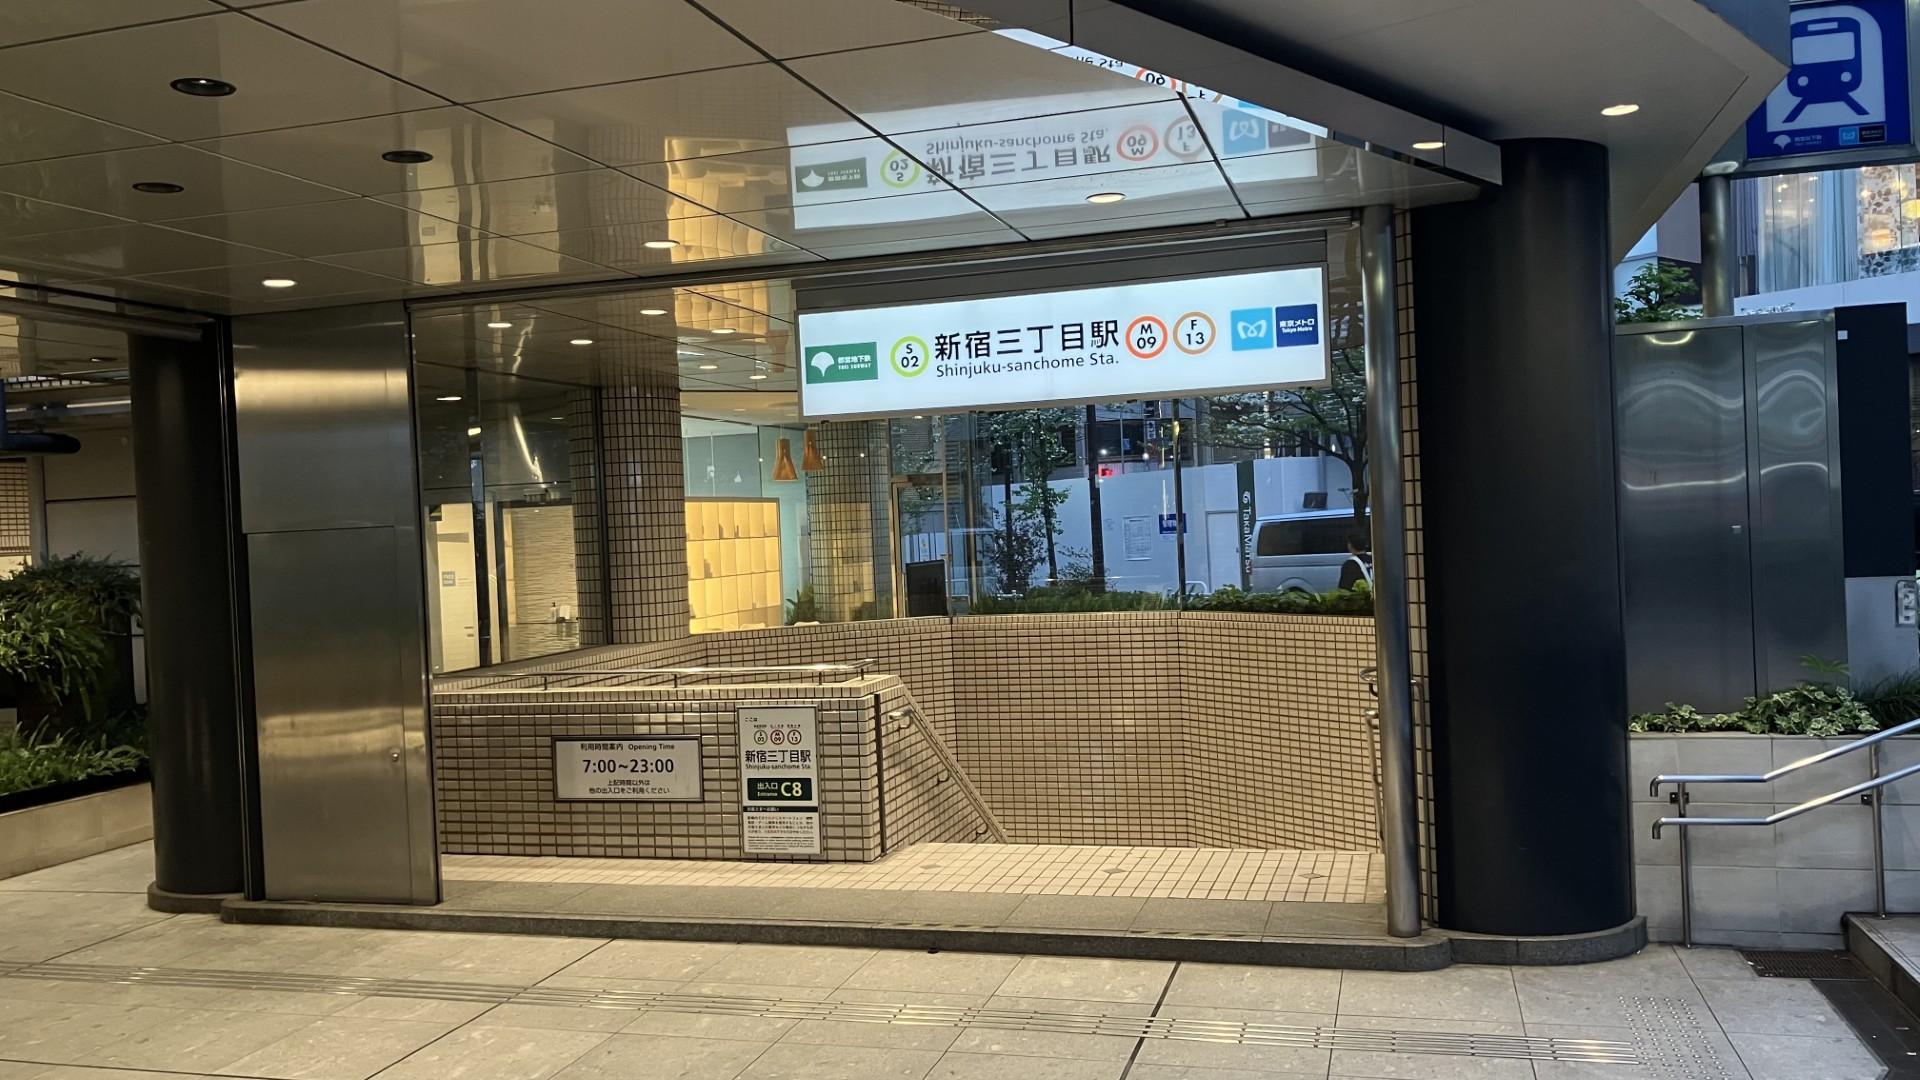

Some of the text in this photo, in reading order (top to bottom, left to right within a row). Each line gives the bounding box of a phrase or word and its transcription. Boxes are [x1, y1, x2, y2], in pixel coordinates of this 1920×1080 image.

[1140, 323, 1153, 335] M
[1190, 319, 1198, 331] F
[1279, 318, 1315, 328] 東京メトロ
[934, 319, 1120, 362] 新宿三丁目駅
[1136, 336, 1157, 350] 09
[1186, 332, 1205, 345] 13
[905, 343, 913, 354] S
[901, 355, 919, 369] 02
[936, 352, 1120, 379] Shinjuku-sanchome Sta.
[628, 743, 657, 751] Opening
[745, 750, 811, 763] 新宿三丁目駅
[745, 763, 800, 771] Shinjuku-sanchome
[780, 782, 802, 796] C8
